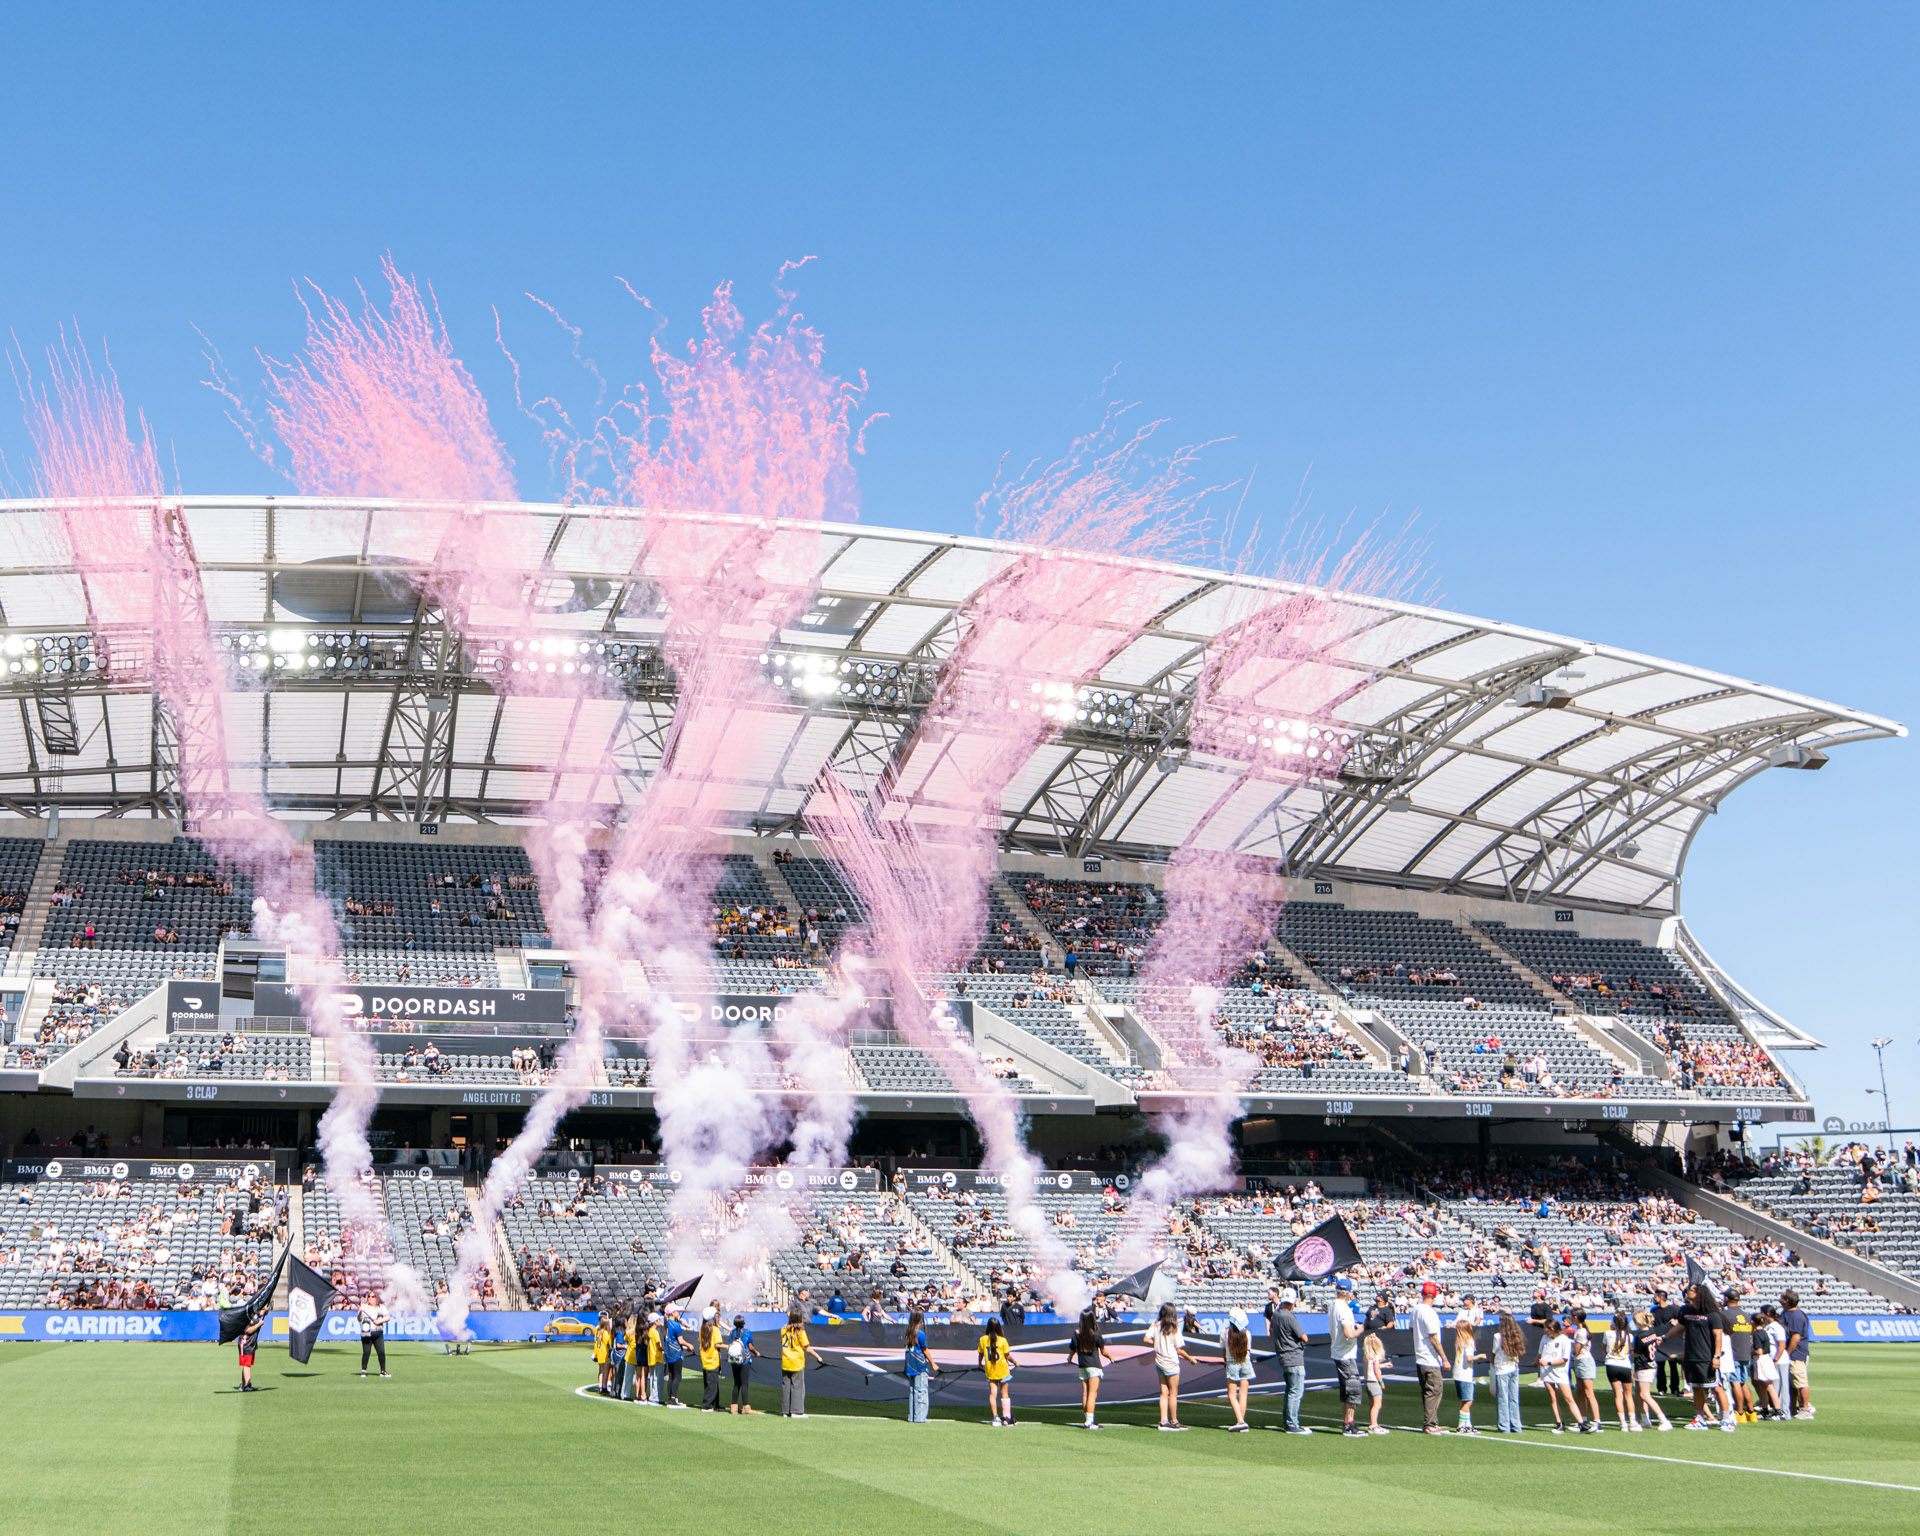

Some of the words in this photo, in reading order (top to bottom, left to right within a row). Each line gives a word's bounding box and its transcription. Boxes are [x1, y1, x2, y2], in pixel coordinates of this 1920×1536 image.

[422, 826, 436, 834] 212
[1085, 864, 1099, 872] 215
[1316, 885, 1331, 893] 216
[512, 993, 526, 1001] M2
[372, 997, 496, 1015] DOORDASH
[172, 1011, 214, 1019] DOORDASH
[187, 1087, 194, 1099] 3
[195, 1087, 218, 1099] CLAP
[463, 1092, 488, 1103] ANGEL
[490, 1093, 509, 1103] CITY
[511, 1093, 521, 1104] FC
[592, 1093, 613, 1105] 6:31
[1326, 1102, 1332, 1113] 3
[1333, 1102, 1353, 1113] CLAP
[1466, 1104, 1472, 1115] 3
[1473, 1104, 1492, 1115] CLAP
[1602, 1106, 1608, 1118] 3
[1609, 1106, 1628, 1118] CLAP
[1736, 1108, 1742, 1120] 3
[1743, 1108, 1762, 1120] CLAP
[1792, 1108, 1808, 1121] 4:01
[17, 1165, 43, 1174] BMO
[84, 1166, 110, 1175] BMO
[150, 1167, 176, 1176] BMO
[215, 1168, 241, 1177] BMO
[393, 1169, 416, 1178] BMO
[547, 1171, 566, 1179] BMO
[649, 1172, 669, 1180] BMO
[745, 1174, 773, 1185] BMO
[917, 1175, 940, 1184] BMO
[808, 1175, 837, 1185] BMO
[975, 1176, 998, 1185] BMO
[1033, 1177, 1056, 1185] BMO
[1090, 1177, 1113, 1187] BMO
[328, 1316, 440, 1335] CAmax
[1855, 1320, 1920, 1336] CARm
